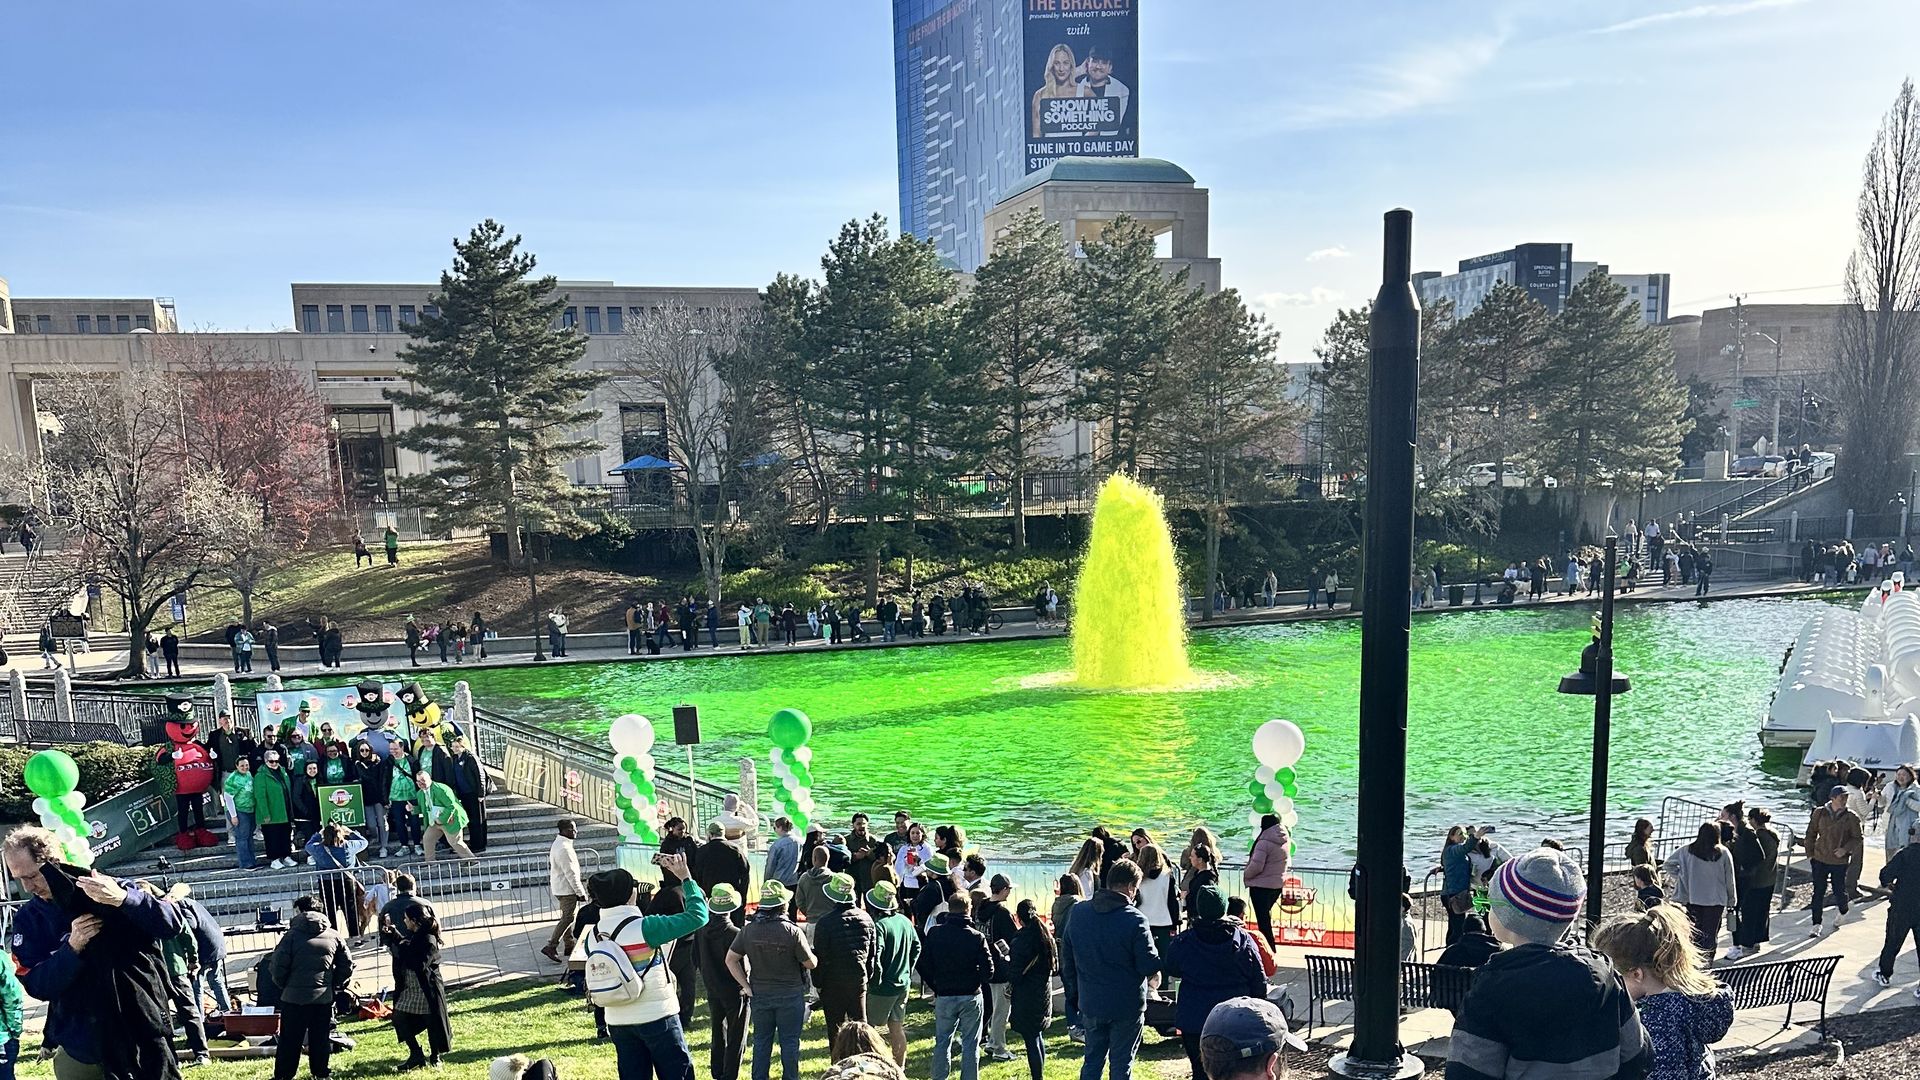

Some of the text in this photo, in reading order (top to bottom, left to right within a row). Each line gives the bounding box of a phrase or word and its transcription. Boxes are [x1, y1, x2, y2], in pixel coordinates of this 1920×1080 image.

[1029, 0, 1131, 11] THE BRACKET
[1066, 24, 1090, 35] with
[1050, 99, 1109, 112] SHOW ME
[1044, 110, 1115, 124] SOMETHING
[1061, 122, 1098, 131] PODCAST
[1027, 140, 1135, 154] TUNE IN TO GAME DAY
[1030, 156, 1063, 169] STOR
[515, 759, 547, 786] 317
[131, 799, 164, 832] 317
[332, 811, 353, 823] 317
[103, 839, 122, 853] PLAY
[1281, 887, 1318, 901] TTERY
[1271, 919, 1327, 930] AMPIONS
